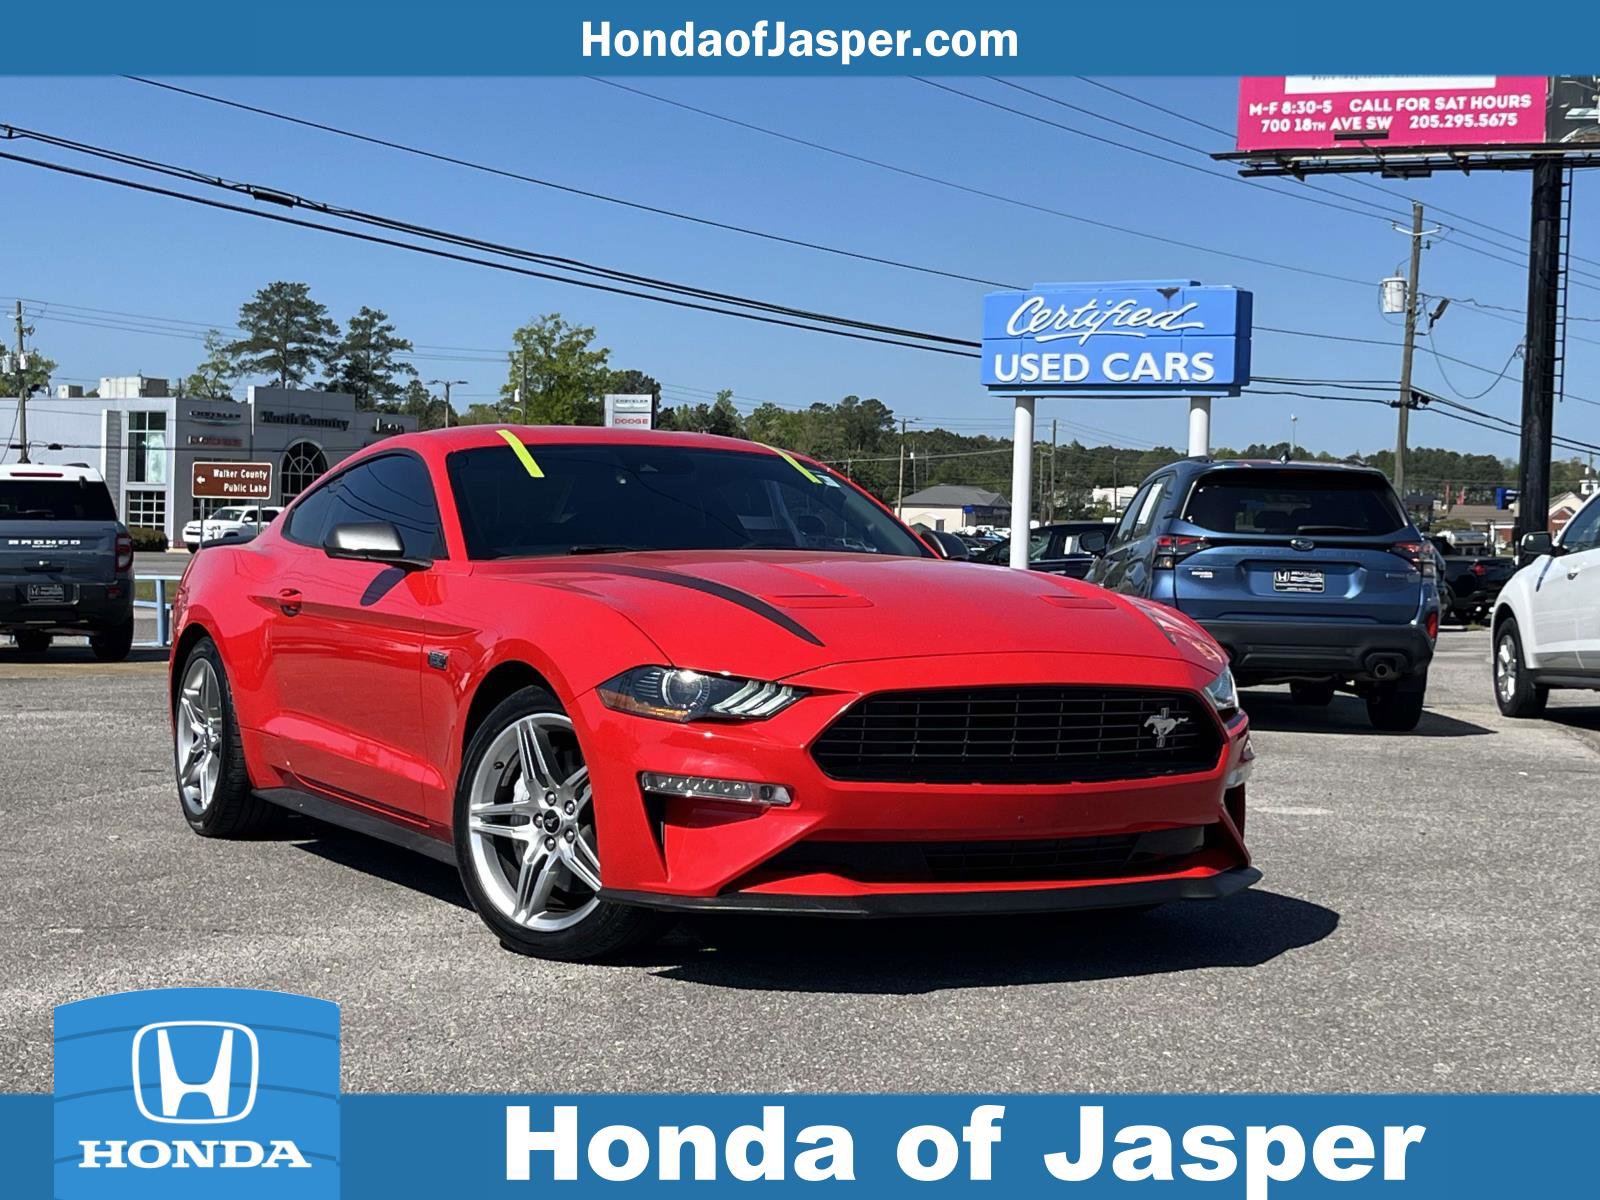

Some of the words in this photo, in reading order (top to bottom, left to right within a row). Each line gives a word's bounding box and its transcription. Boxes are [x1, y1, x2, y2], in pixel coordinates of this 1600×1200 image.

[1249, 102, 1278, 116] M-F
[1281, 99, 1333, 115] 8:30-5
[1349, 98, 1393, 113] CALL
[1396, 97, 1431, 112] FOR
[1434, 96, 1467, 111] SAT
[1470, 94, 1532, 110] HOURS
[1261, 118, 1291, 133] 700
[1329, 116, 1362, 131] AVE
[1365, 115, 1394, 130] SW
[1409, 112, 1518, 129] 205.295.5675
[1006, 296, 1204, 346] Certified
[994, 353, 1090, 383] USED
[1102, 352, 1215, 382] CARS
[213, 468, 238, 478] Walker
[240, 469, 268, 481] County
[223, 482, 247, 493] Public
[249, 483, 267, 493] Lake
